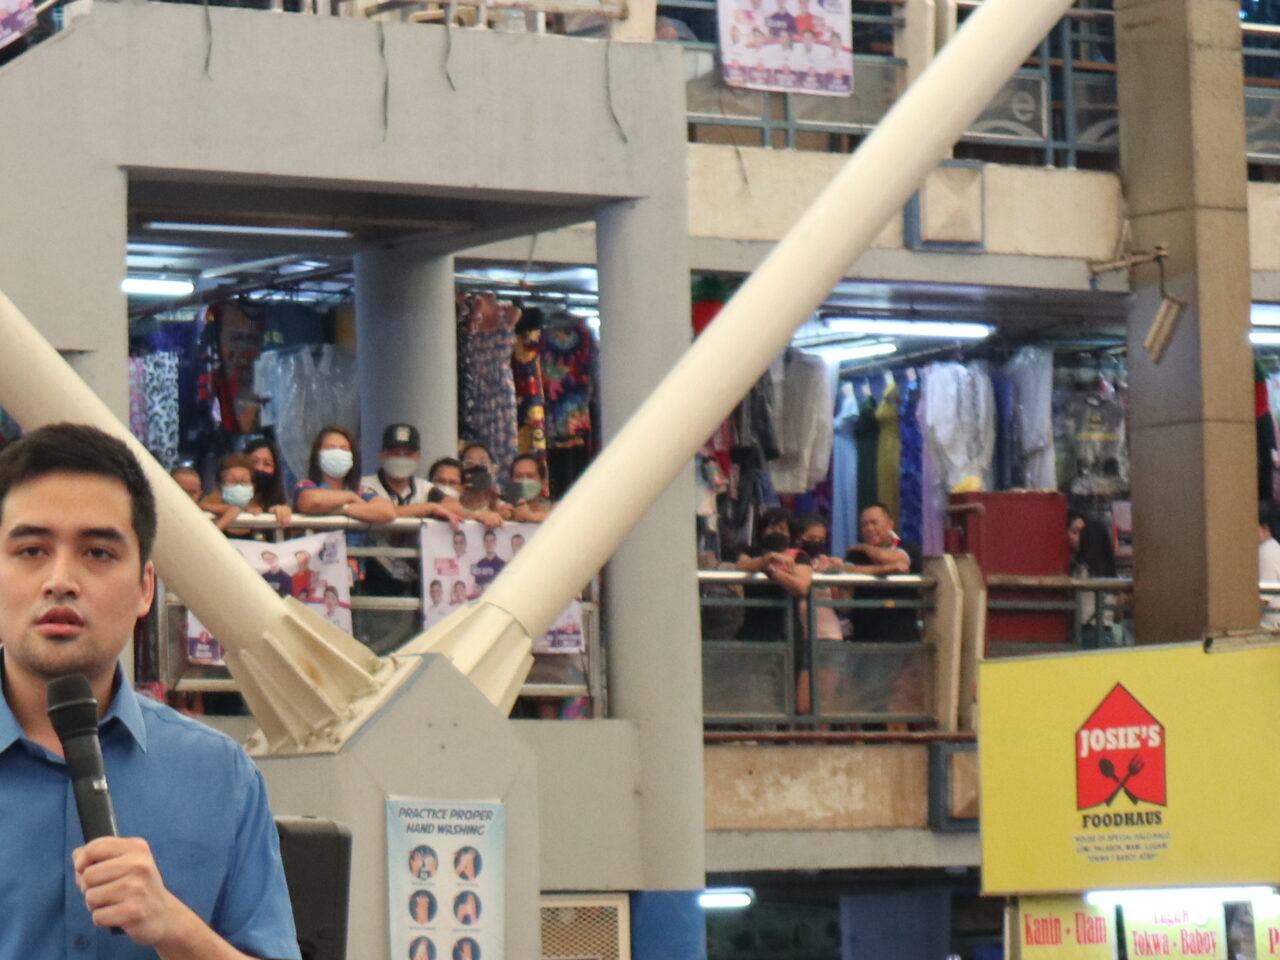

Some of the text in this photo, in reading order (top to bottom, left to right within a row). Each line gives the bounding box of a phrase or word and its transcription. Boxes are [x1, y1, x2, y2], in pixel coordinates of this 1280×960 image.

[1079, 725, 1161, 759] JOSIE'S
[398, 807, 494, 822] PRACTICE PROPER
[1082, 811, 1163, 828] FOODHAUS
[406, 823, 486, 836] HAND WASHING
[1024, 912, 1062, 946] Kanin
[1075, 911, 1108, 946] Ulam
[1132, 929, 1171, 957] Tokwa
[1181, 928, 1218, 958] Baboy
